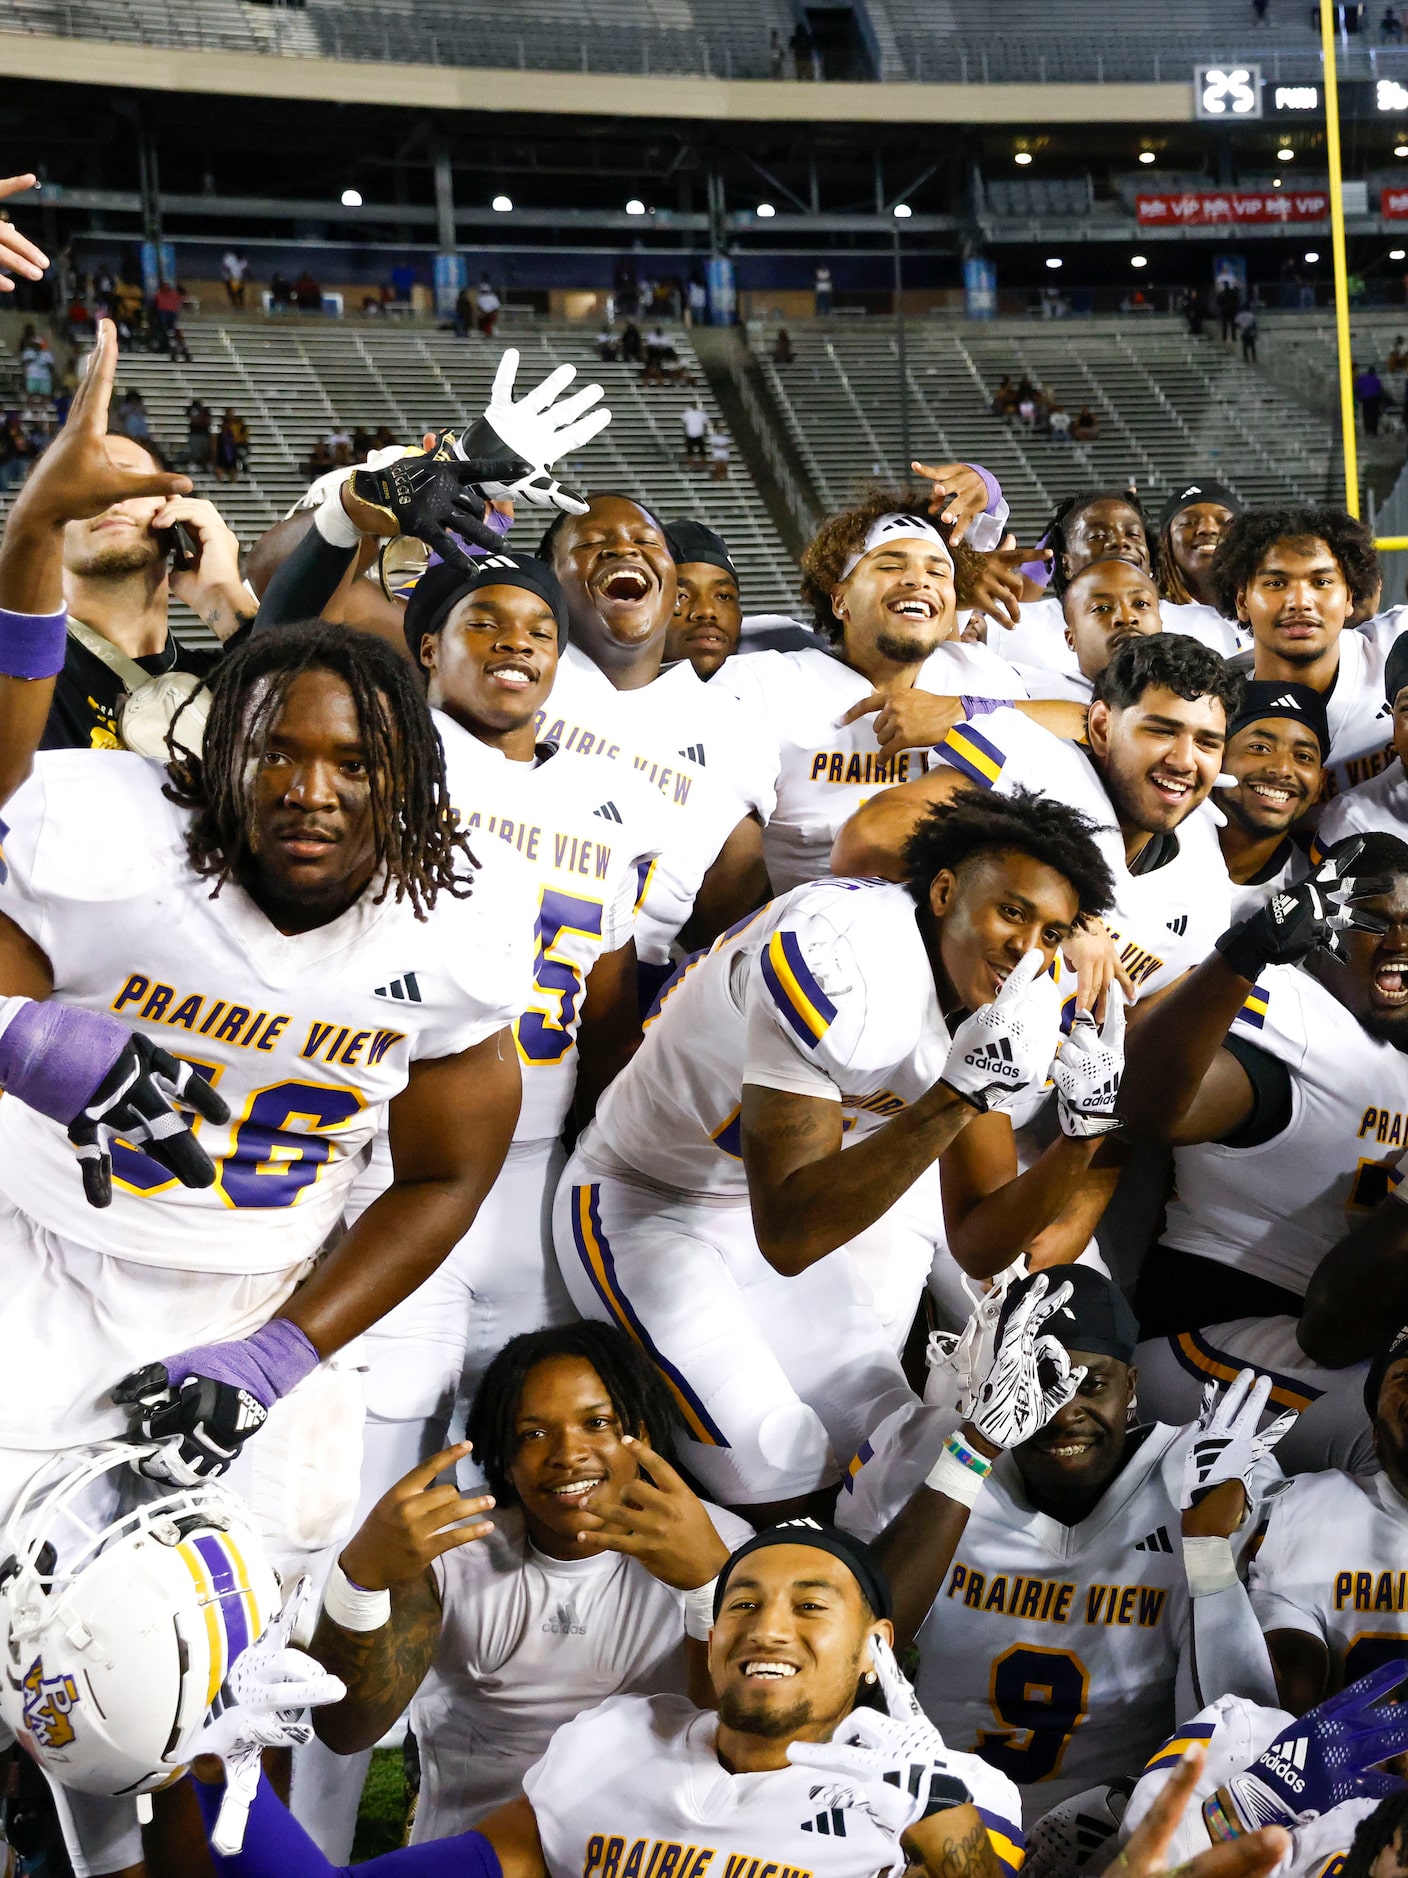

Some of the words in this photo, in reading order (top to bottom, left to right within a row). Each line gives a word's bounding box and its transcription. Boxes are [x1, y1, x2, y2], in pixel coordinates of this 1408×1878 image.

[810, 751, 911, 785] PRAIRIE
[554, 832, 612, 881] VIEW
[1271, 894, 1285, 925] adidas
[513, 882, 604, 1067] 5
[1119, 942, 1165, 988] VIEW
[110, 973, 292, 1054] PRAIRIE
[299, 1020, 407, 1068] VIEW
[965, 1052, 1020, 1079] adidas
[947, 1561, 1076, 1624] PRAIRIE
[1085, 1584, 1168, 1628] VIEW
[541, 1623, 586, 1635] addas
[968, 1641, 1091, 1785] 9
[1260, 1752, 1306, 1794] adidas
[584, 1833, 718, 1878] PRAIRIE
